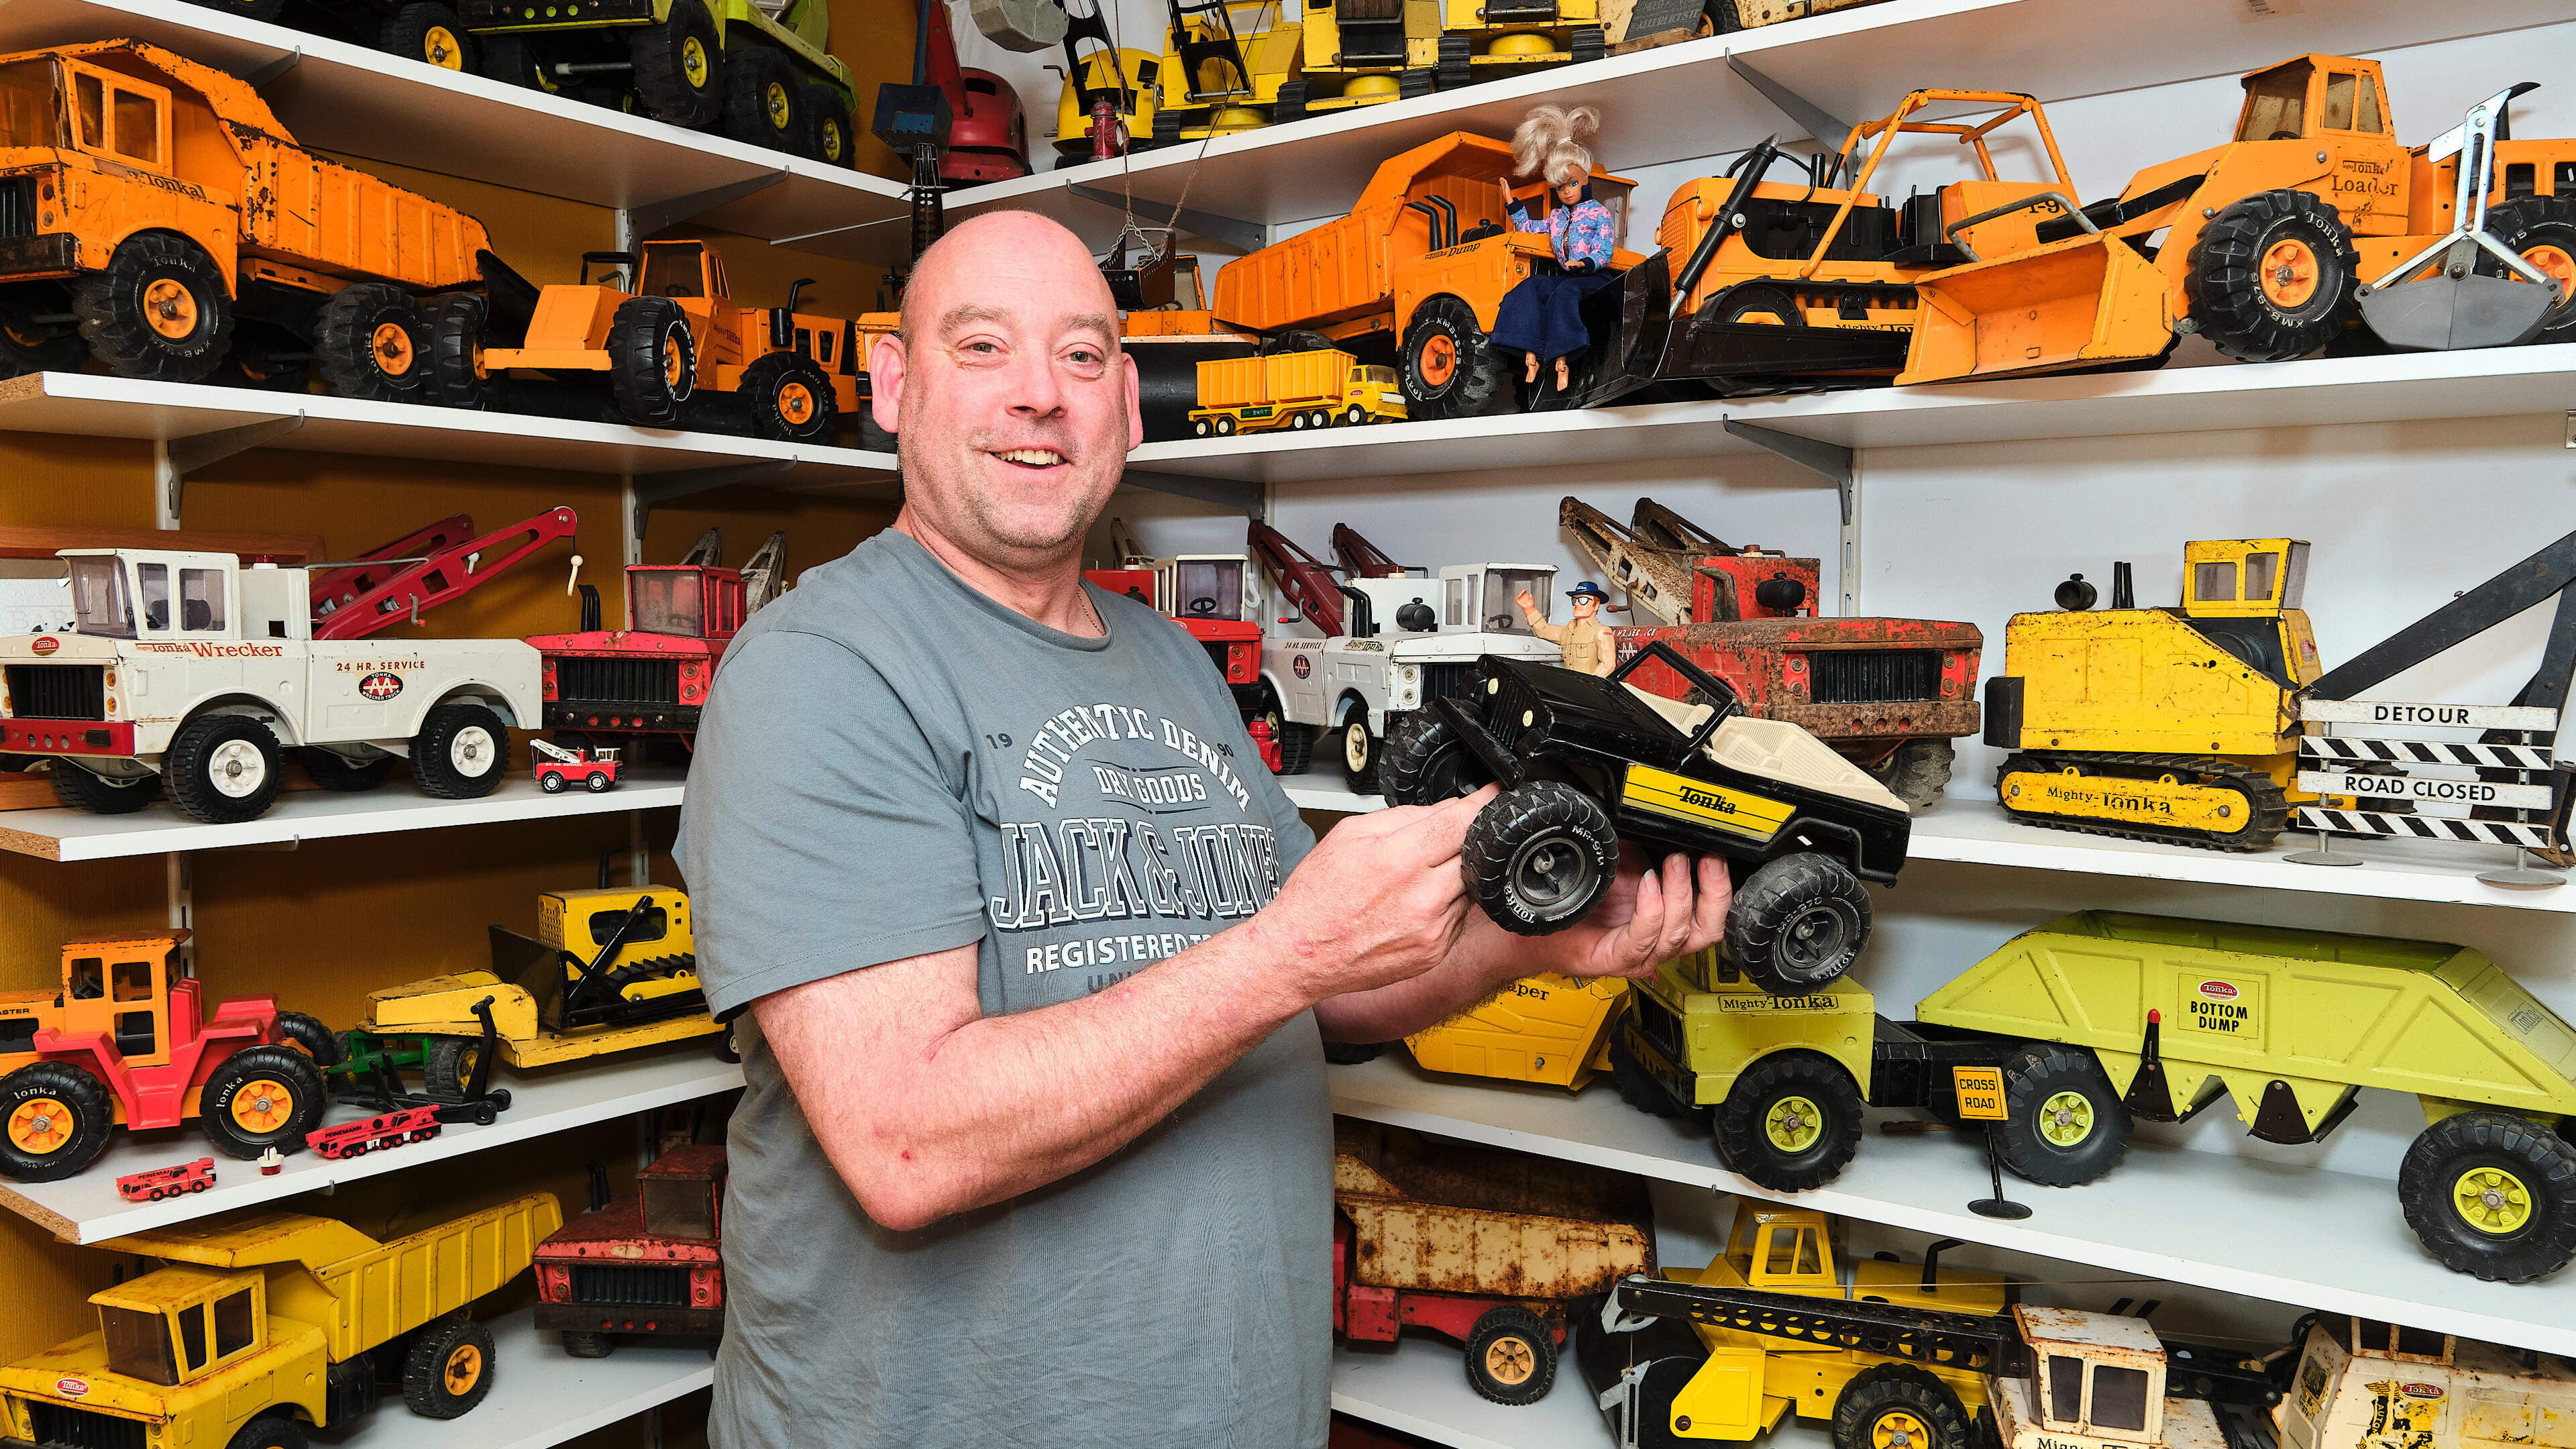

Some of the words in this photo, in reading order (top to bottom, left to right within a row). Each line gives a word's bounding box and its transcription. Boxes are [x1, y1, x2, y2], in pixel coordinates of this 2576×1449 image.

[1447, 241, 1481, 258] Dump
[36, 640, 57, 649] Tonka
[189, 642, 283, 657] Wrecker
[336, 663, 351, 672] 24
[380, 661, 425, 670] SERVICE
[2375, 705, 2469, 724] DETOUR
[985, 733, 1014, 749] 19
[1018, 702, 1155, 810] AUTHENTIC
[1159, 717, 1252, 812] DENIM
[1217, 742, 1234, 759] 90
[1091, 766, 1136, 798] DRY
[1134, 772, 1208, 805] GOODS
[2345, 775, 2405, 794] ROAD
[2413, 781, 2496, 801] CLOSED
[1679, 785, 1736, 815] Tonka
[1503, 881, 1536, 924] Tonka
[2204, 984, 2235, 994] Tonka
[2190, 1000, 2248, 1020] BOTTOM
[2198, 1016, 2240, 1032] DUMP
[13, 1086, 57, 1099] Tonka
[215, 1077, 244, 1108] Tonka
[1959, 1079, 1996, 1091] CROSS
[1964, 1097, 1996, 1109] ROAD
[325, 1125, 362, 1138] PEINEMANN
[62, 1381, 85, 1391] Tonka
